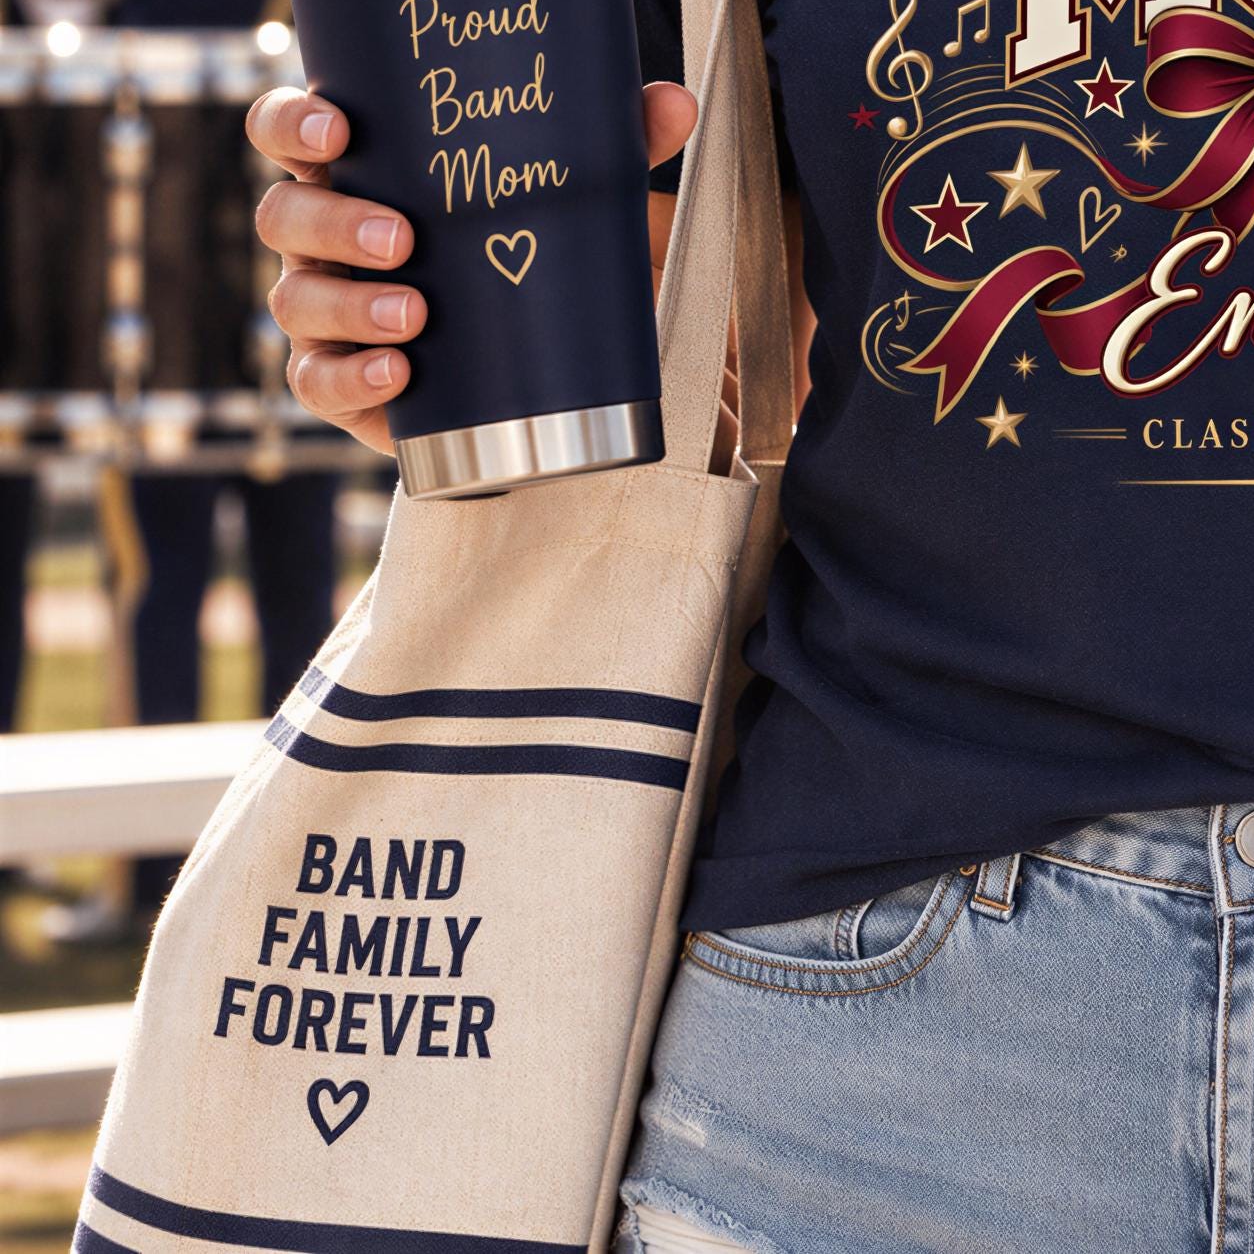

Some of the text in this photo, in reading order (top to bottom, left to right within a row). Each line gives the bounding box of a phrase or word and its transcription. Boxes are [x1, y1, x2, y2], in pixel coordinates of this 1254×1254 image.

[420, 52, 554, 136] Band
[428, 142, 569, 214] Mom
[296, 833, 466, 900] BAND
[257, 905, 482, 977] FAMILY
[213, 976, 496, 1059] FOREVER
